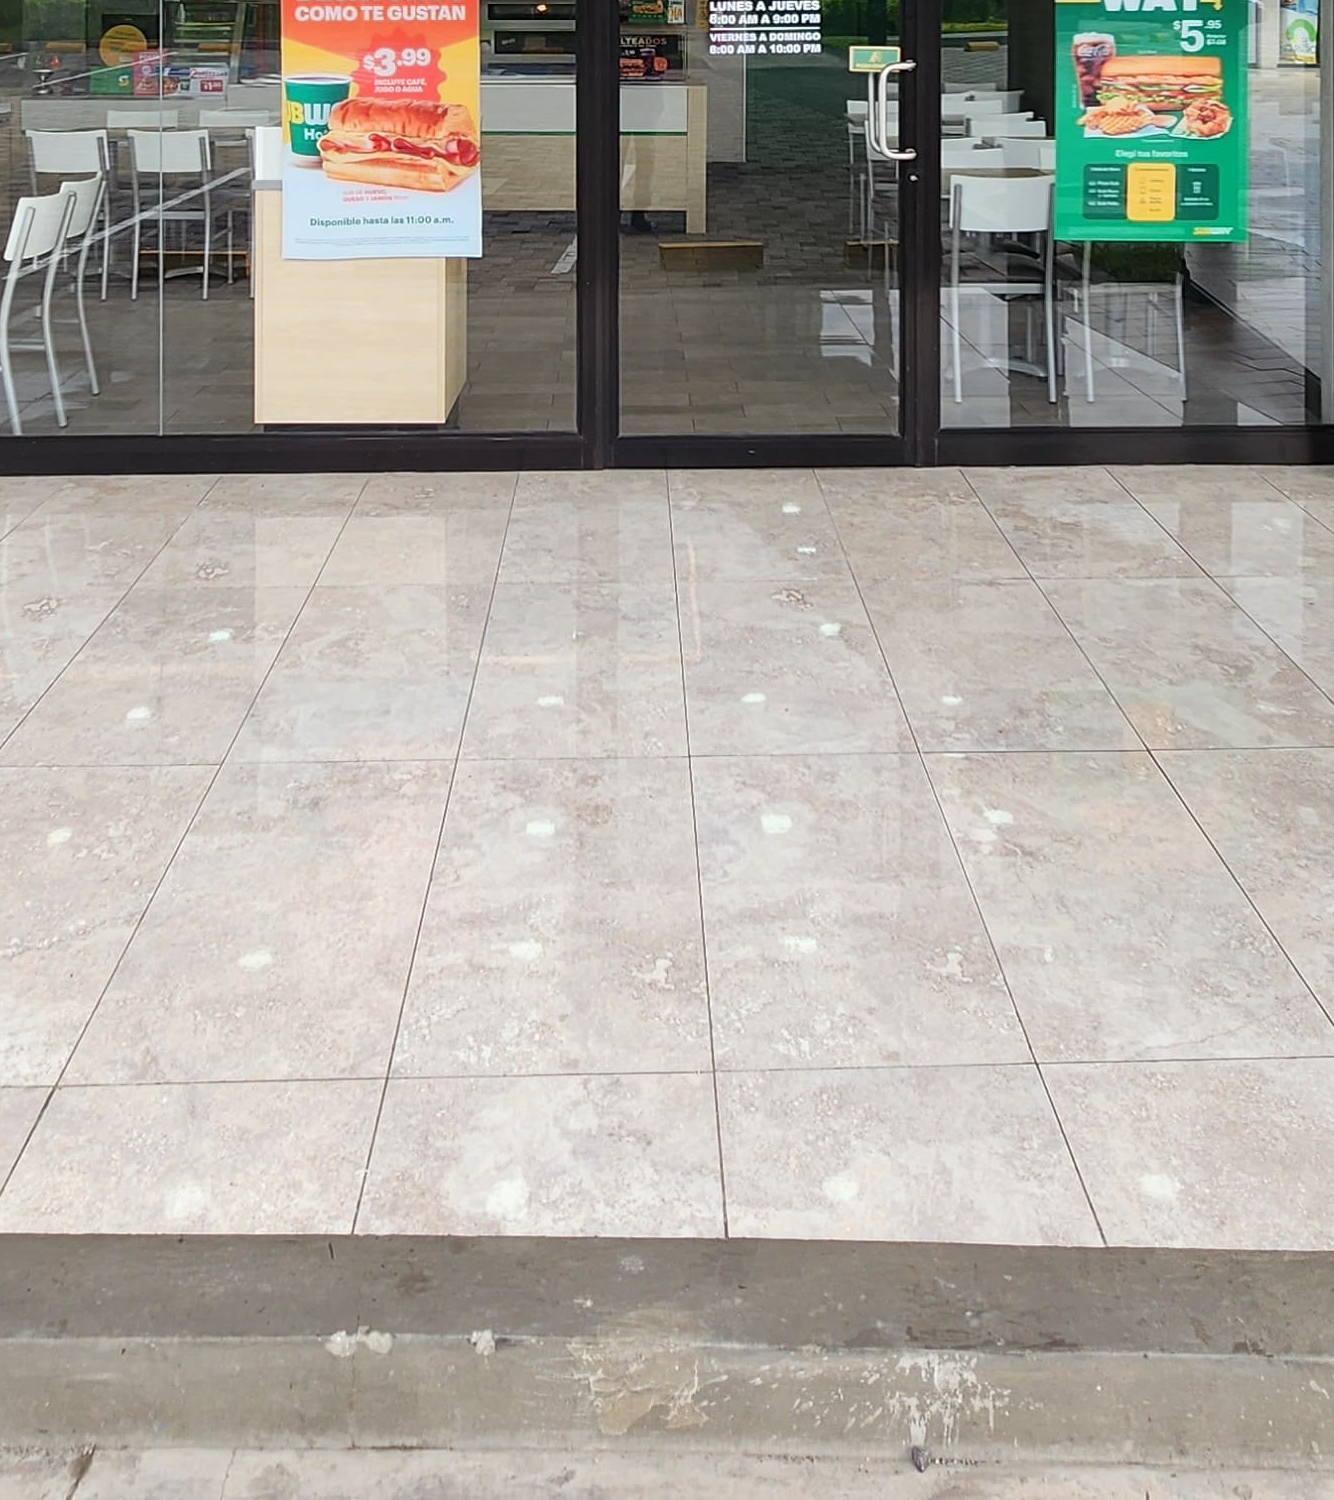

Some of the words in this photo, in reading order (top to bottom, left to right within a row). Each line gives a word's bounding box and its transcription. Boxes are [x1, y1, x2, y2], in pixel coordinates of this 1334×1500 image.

[710, 1, 753, 12] LUNES
[755, 1, 766, 12] A
[768, 0, 821, 11] JUEVES
[295, 5, 358, 21] COMO
[361, 6, 384, 21] TE
[387, 5, 466, 21] GUSTAN
[709, 14, 736, 25] 8:00
[738, 14, 758, 24] AM
[760, 14, 770, 24] A
[772, 13, 799, 24] 9:00
[801, 13, 821, 24] PM
[710, 32, 757, 42] VIERNES
[758, 32, 768, 41] A
[769, 31, 821, 41] DOMINGO
[709, 45, 735, 55] 8:00
[736, 45, 756, 54] AM
[757, 44, 767, 54] A
[769, 44, 801, 54] 10:00
[802, 44, 822, 53] PM
[363, 47, 432, 77] $3.99
[310, 217, 362, 227] Disponible
[363, 217, 389, 225] hasta
[391, 216, 404, 224] las
[406, 216, 432, 224] 11:00
